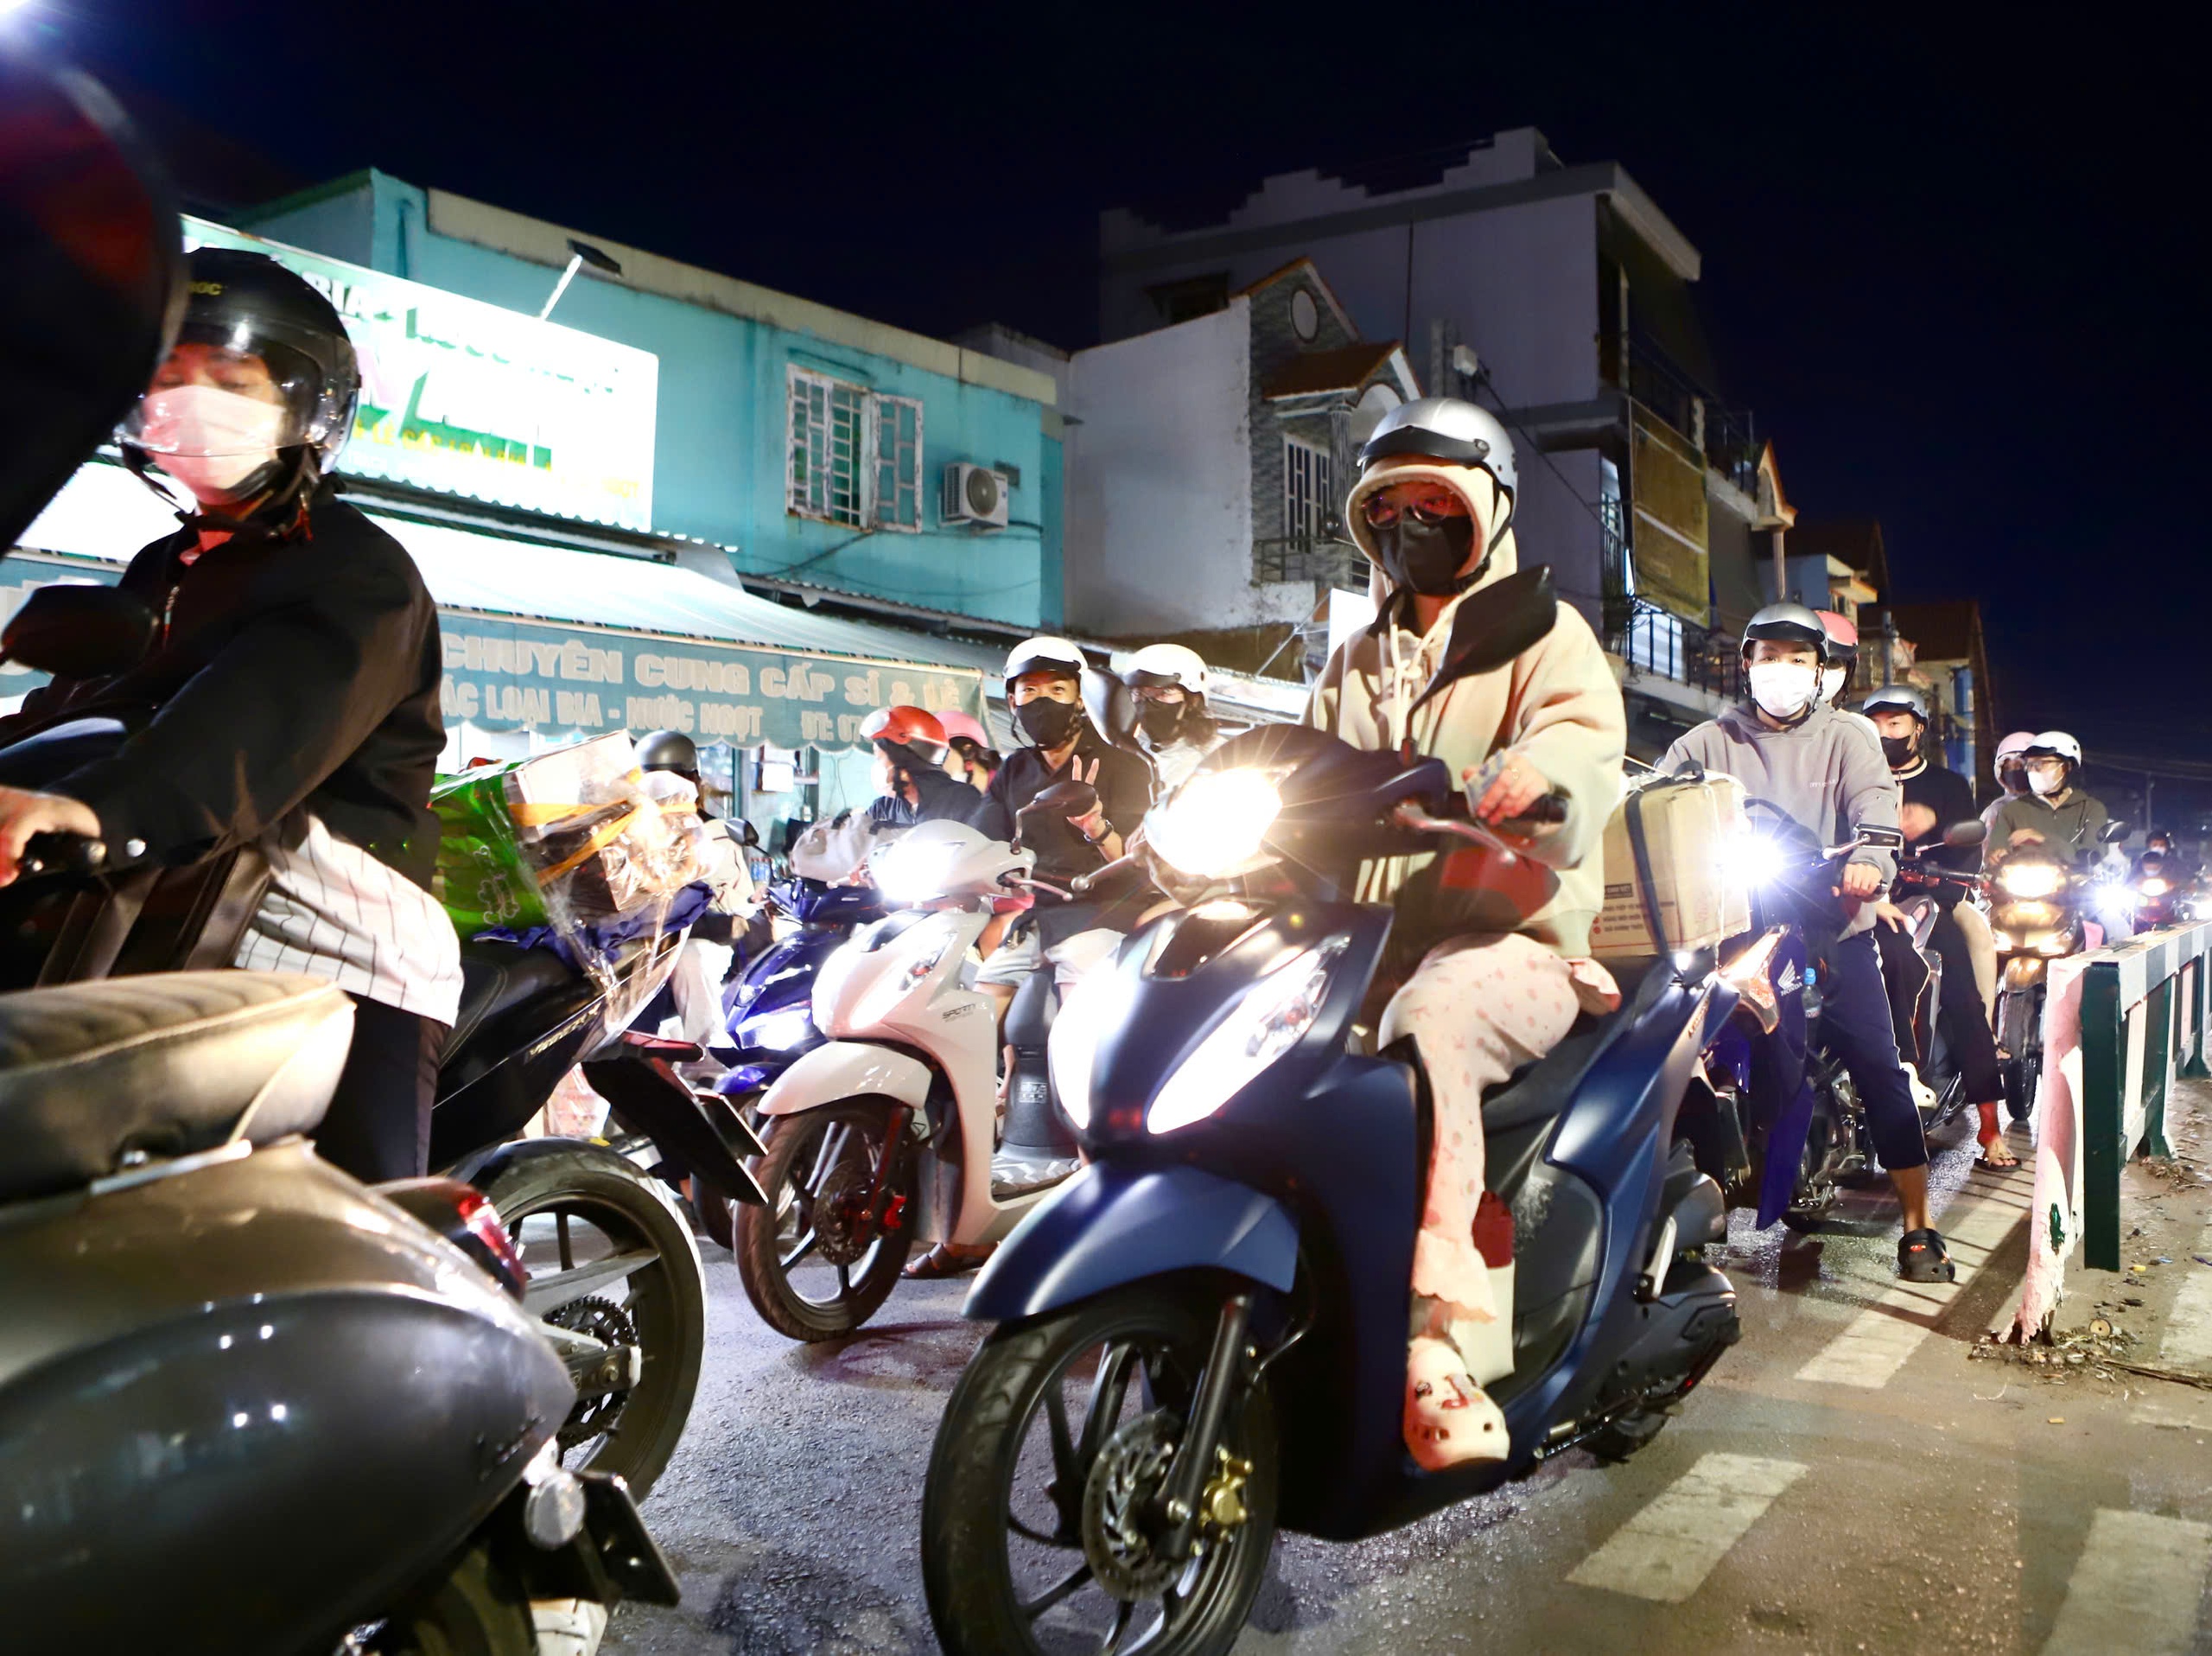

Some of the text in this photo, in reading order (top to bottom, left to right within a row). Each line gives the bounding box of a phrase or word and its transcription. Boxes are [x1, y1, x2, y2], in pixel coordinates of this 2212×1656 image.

[439, 632, 623, 684] CHUYÊN
[634, 653, 750, 695] CUNG
[760, 662, 836, 702] CẤP
[439, 673, 479, 718] ÁC
[486, 685, 551, 729] LOẠI
[556, 691, 603, 727] BIA
[700, 702, 764, 743] NGỌT
[1780, 982, 1803, 997] HONDA
